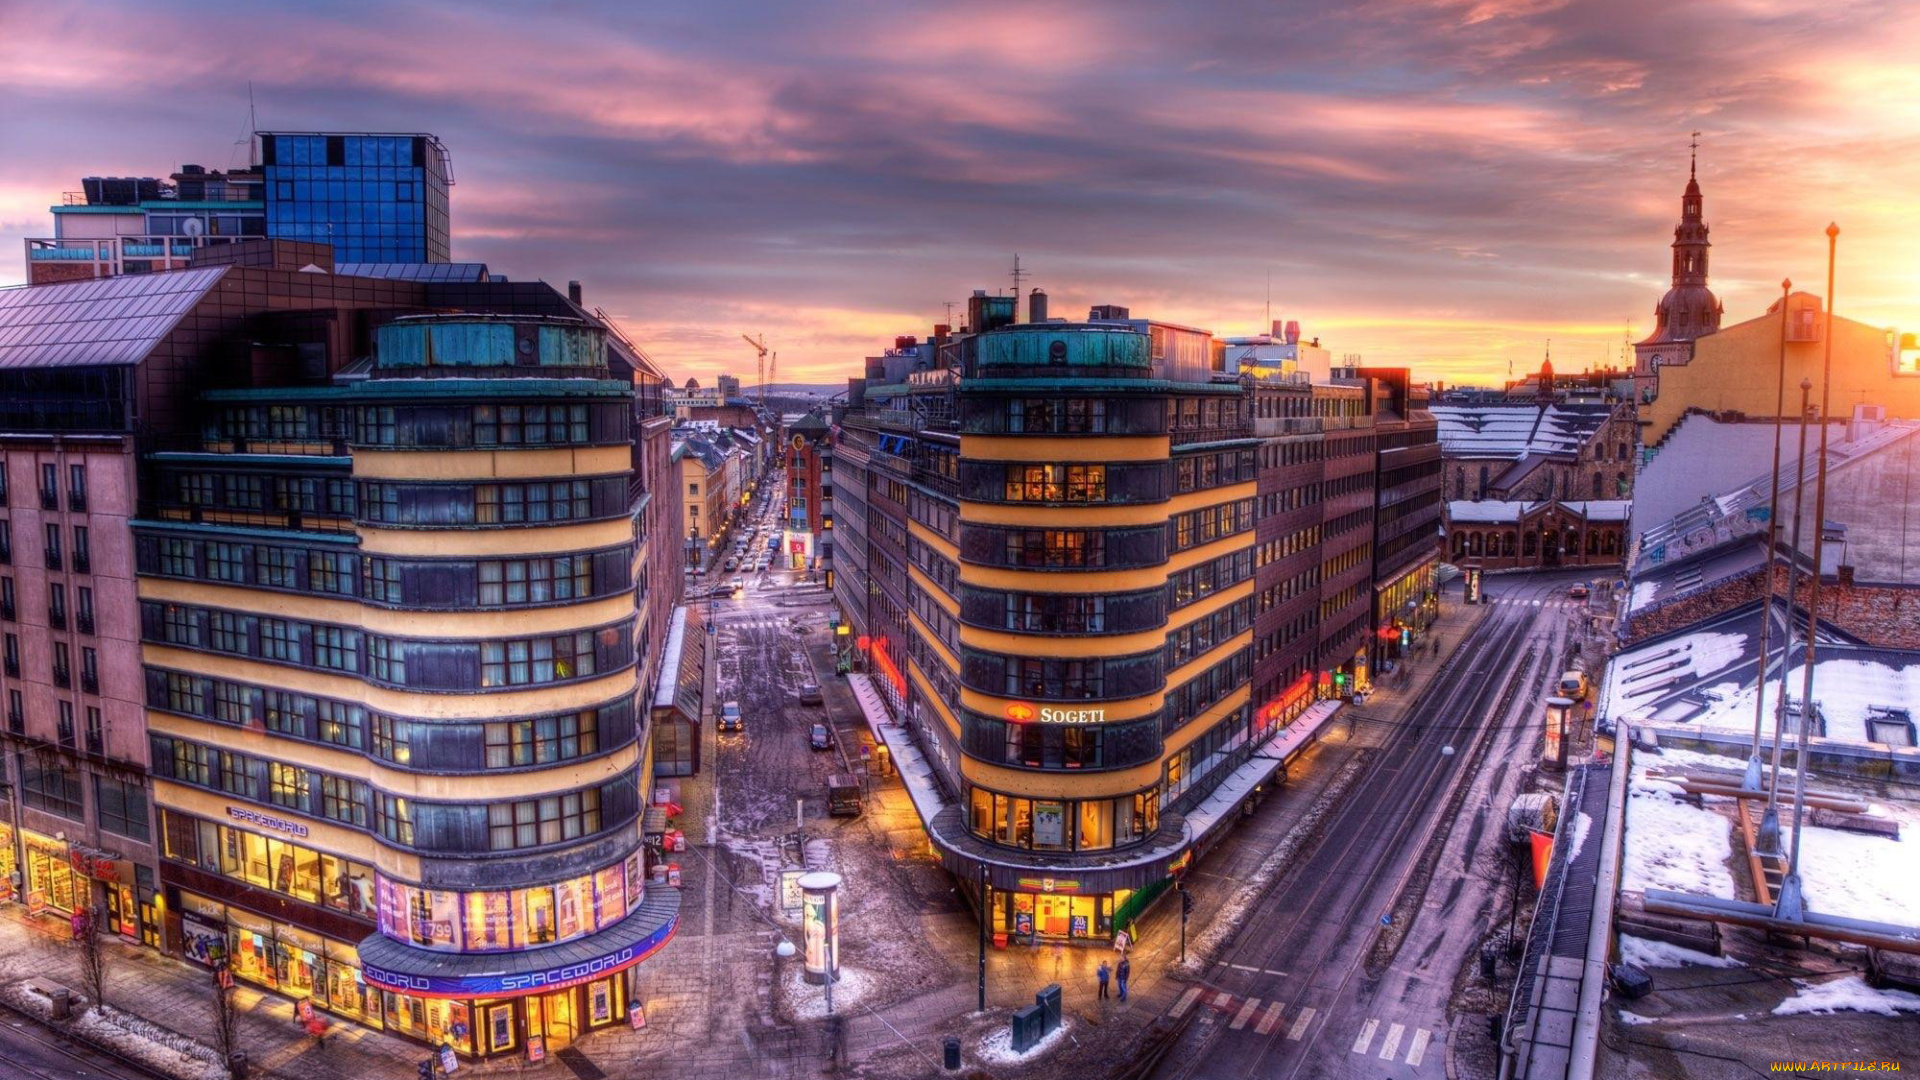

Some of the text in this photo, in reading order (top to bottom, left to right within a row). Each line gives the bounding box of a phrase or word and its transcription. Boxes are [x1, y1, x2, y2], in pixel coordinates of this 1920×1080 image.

[230, 807, 308, 837] SPACEWORLD
[428, 923, 452, 938] 799
[502, 948, 633, 990] SPACEWORLD
